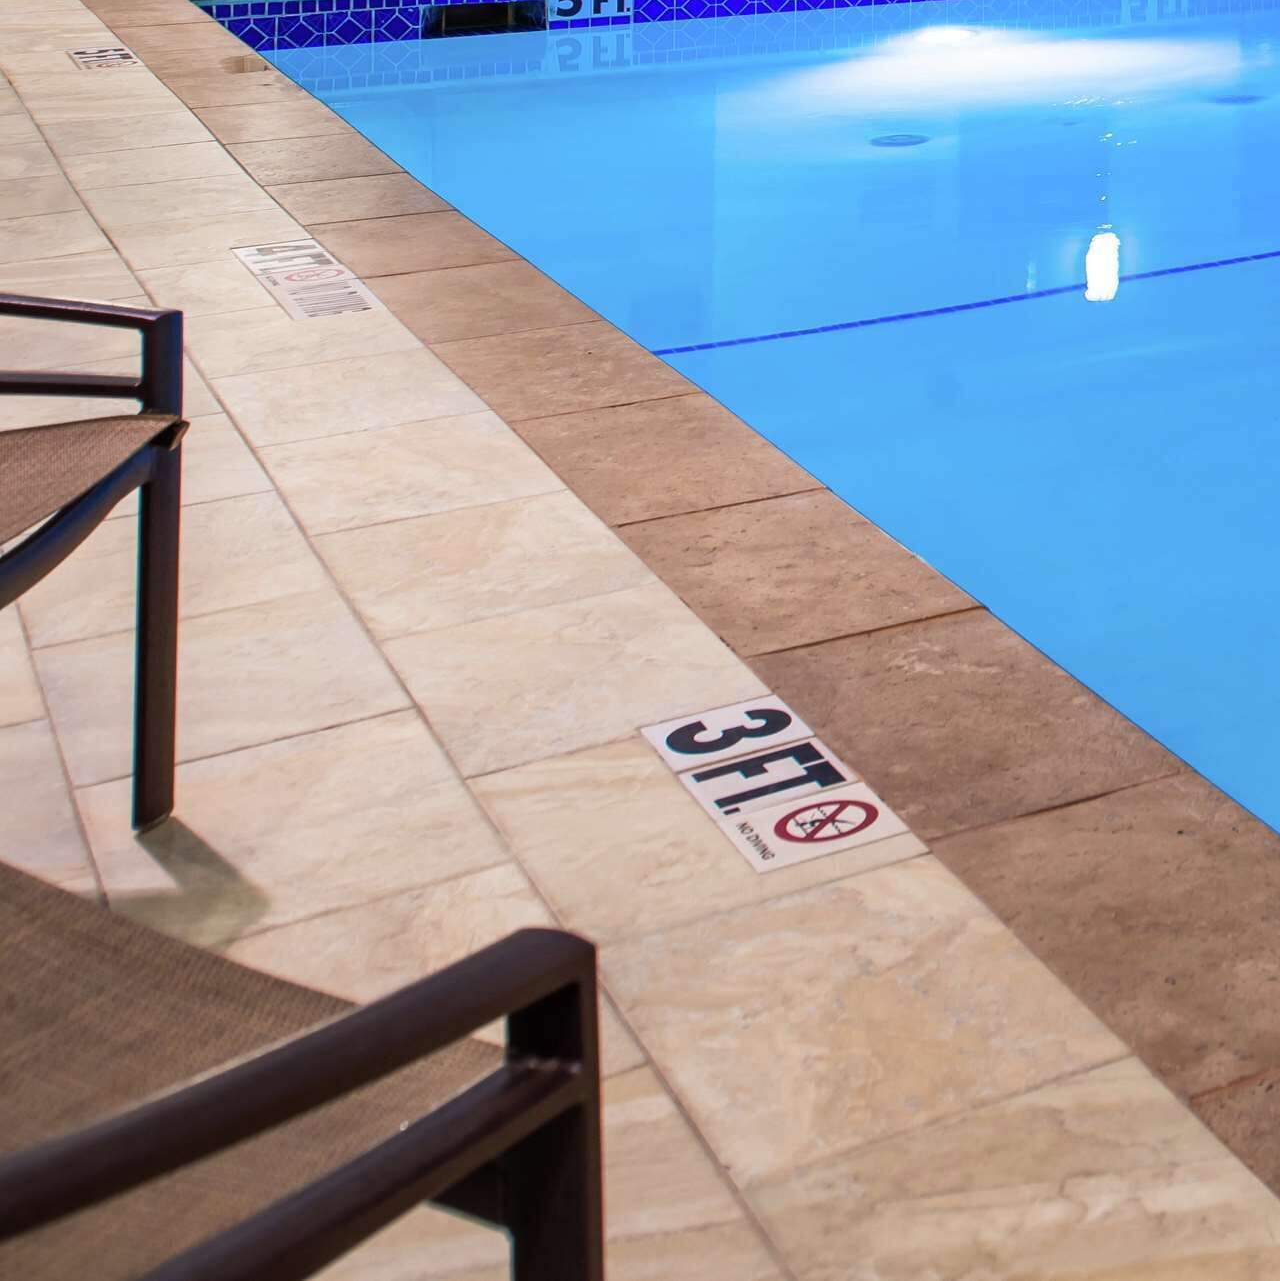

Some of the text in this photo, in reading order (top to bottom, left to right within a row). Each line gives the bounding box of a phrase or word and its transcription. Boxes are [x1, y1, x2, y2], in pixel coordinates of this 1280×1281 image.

[665, 708, 847, 816] 3 FT.
[736, 821, 776, 860] NO DIVING
